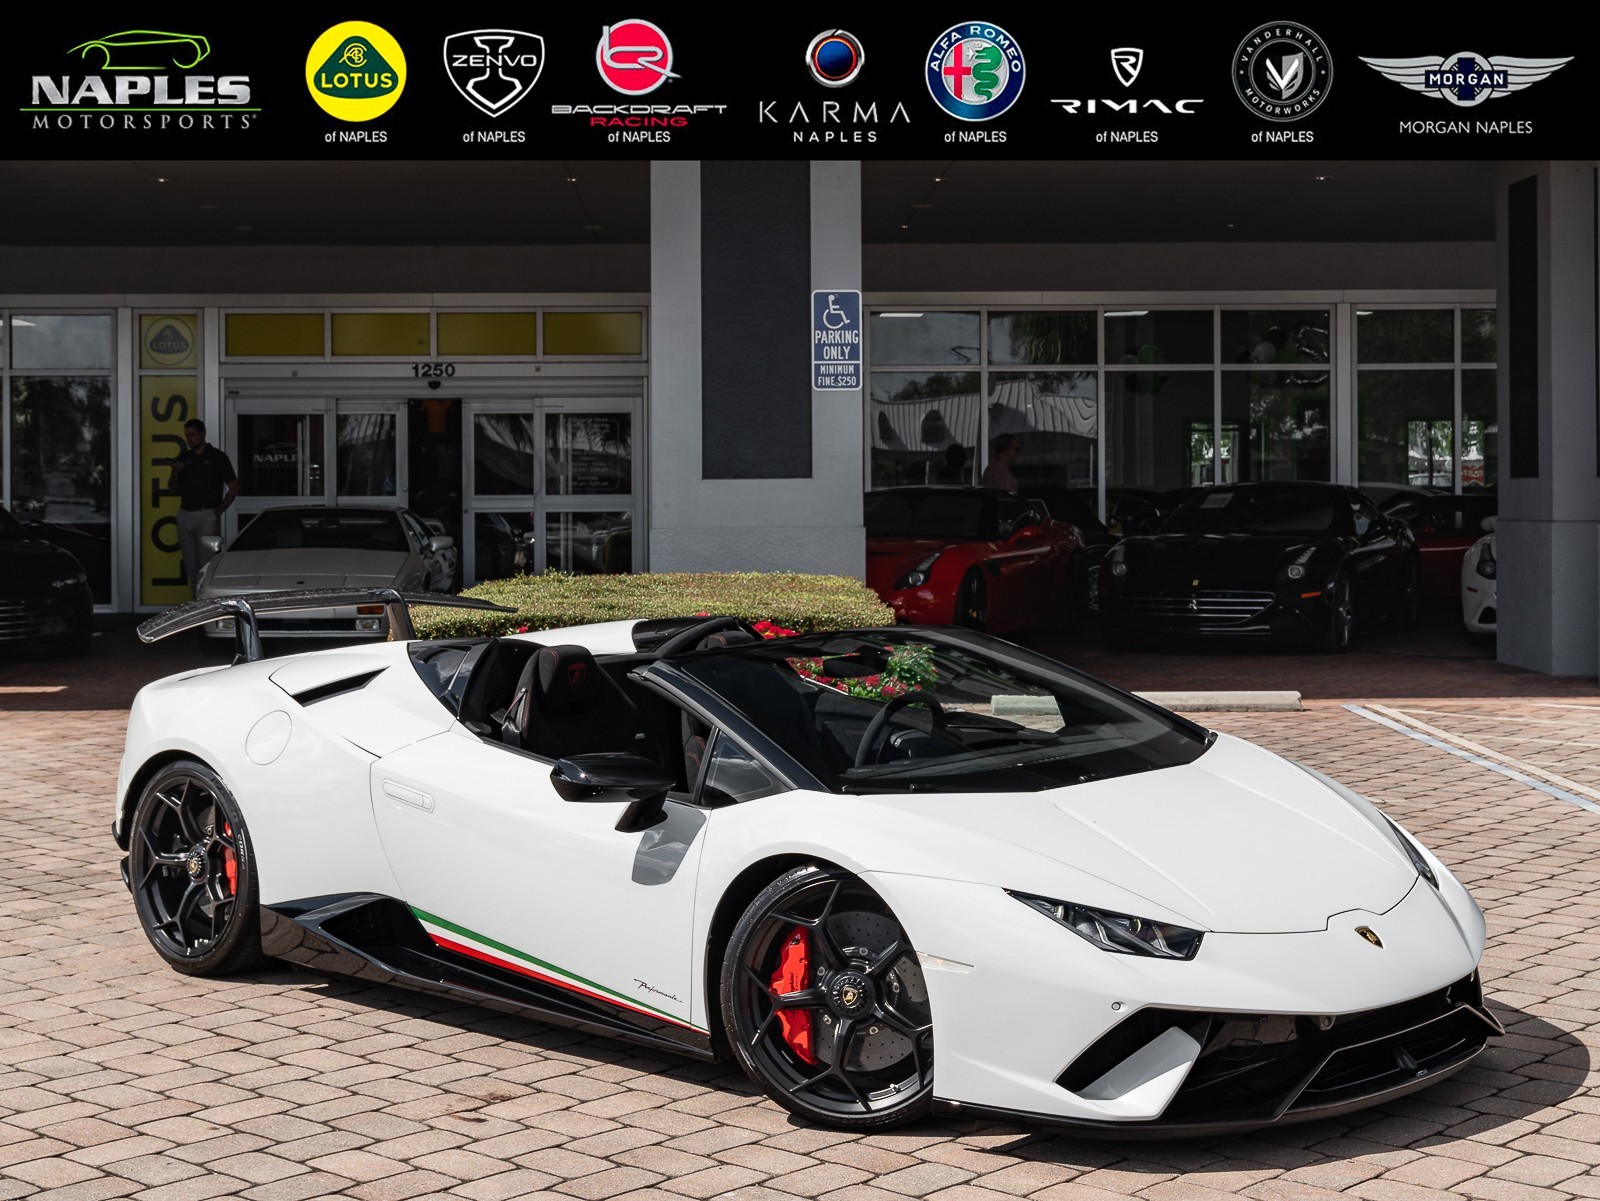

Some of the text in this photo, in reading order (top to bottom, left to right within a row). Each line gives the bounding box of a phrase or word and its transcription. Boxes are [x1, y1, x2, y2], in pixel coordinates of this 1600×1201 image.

[815, 330, 859, 344] PARKING
[152, 341, 188, 350] LOTUS
[823, 345, 851, 360] ONLY
[412, 363, 456, 378] 1250
[820, 365, 854, 375] MINIMUM
[818, 376, 856, 387] FINE $250
[253, 453, 305, 463] NAPLE
[151, 393, 189, 587] LOTUS
